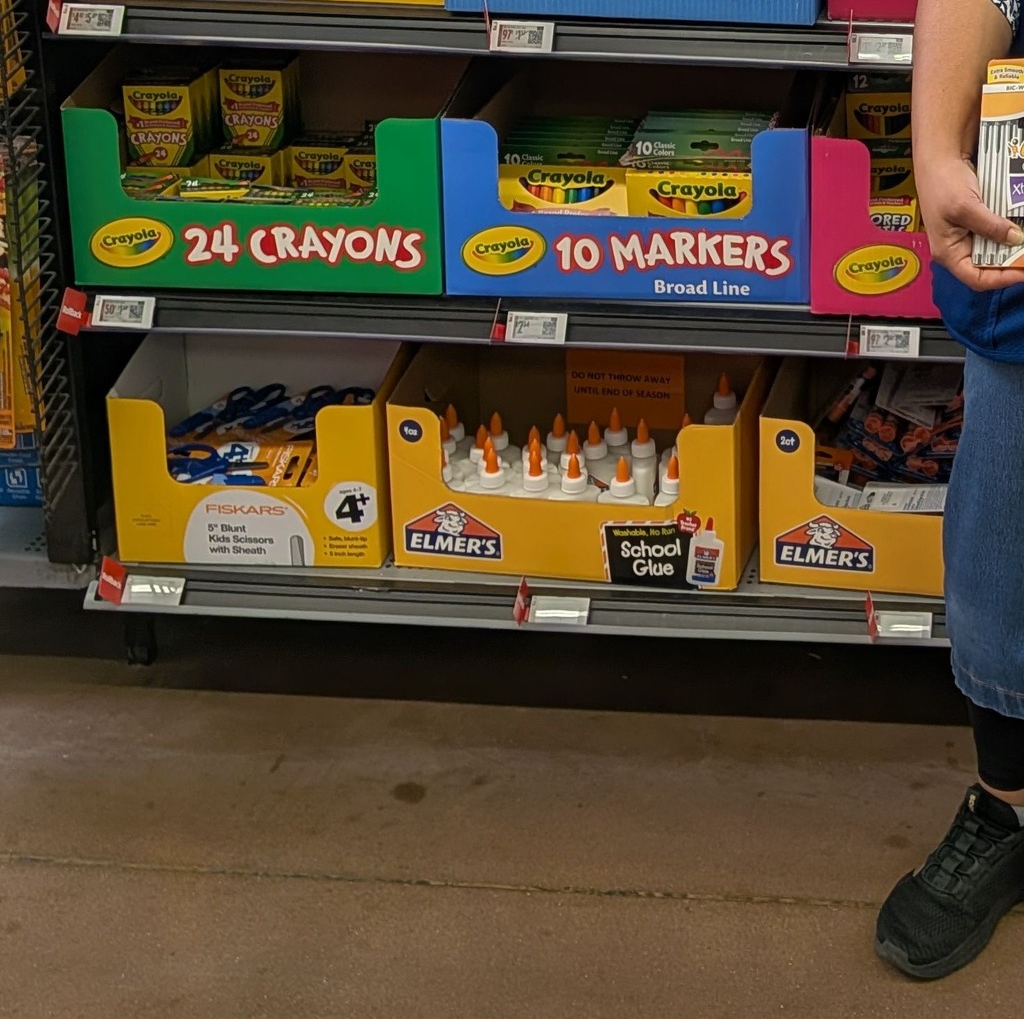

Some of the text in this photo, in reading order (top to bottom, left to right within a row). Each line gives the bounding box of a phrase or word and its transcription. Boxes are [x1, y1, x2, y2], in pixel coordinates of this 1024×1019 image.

[132, 89, 178, 103] Crayola
[130, 132, 187, 145] CRAYONS
[653, 141, 676, 150] Classic
[636, 140, 653, 155] 10
[652, 149, 676, 159] Colors
[528, 169, 606, 187] Crayola
[658, 181, 737, 200] Crayola
[102, 228, 160, 248] Crayola
[184, 226, 423, 269] 24 CRAYONS
[474, 236, 530, 256] Crayola
[556, 232, 791, 275] 10 MARKERS
[848, 256, 906, 274] Crayola
[654, 280, 750, 296] Broad Line
[572, 371, 671, 384] DO NOT THROW AWAY
[573, 386, 671, 399] UNTIL END OF SEASON
[780, 436, 795, 447] 2ct
[206, 504, 286, 516] FISKARS
[208, 523, 246, 533] 5" Blunt
[612, 527, 676, 537] Washable, No Run
[208, 534, 274, 545] Kids Scissors
[410, 532, 494, 555] ELMER'S
[209, 546, 267, 555] with Sheath
[620, 538, 682, 558] School
[632, 559, 675, 577] Glue
